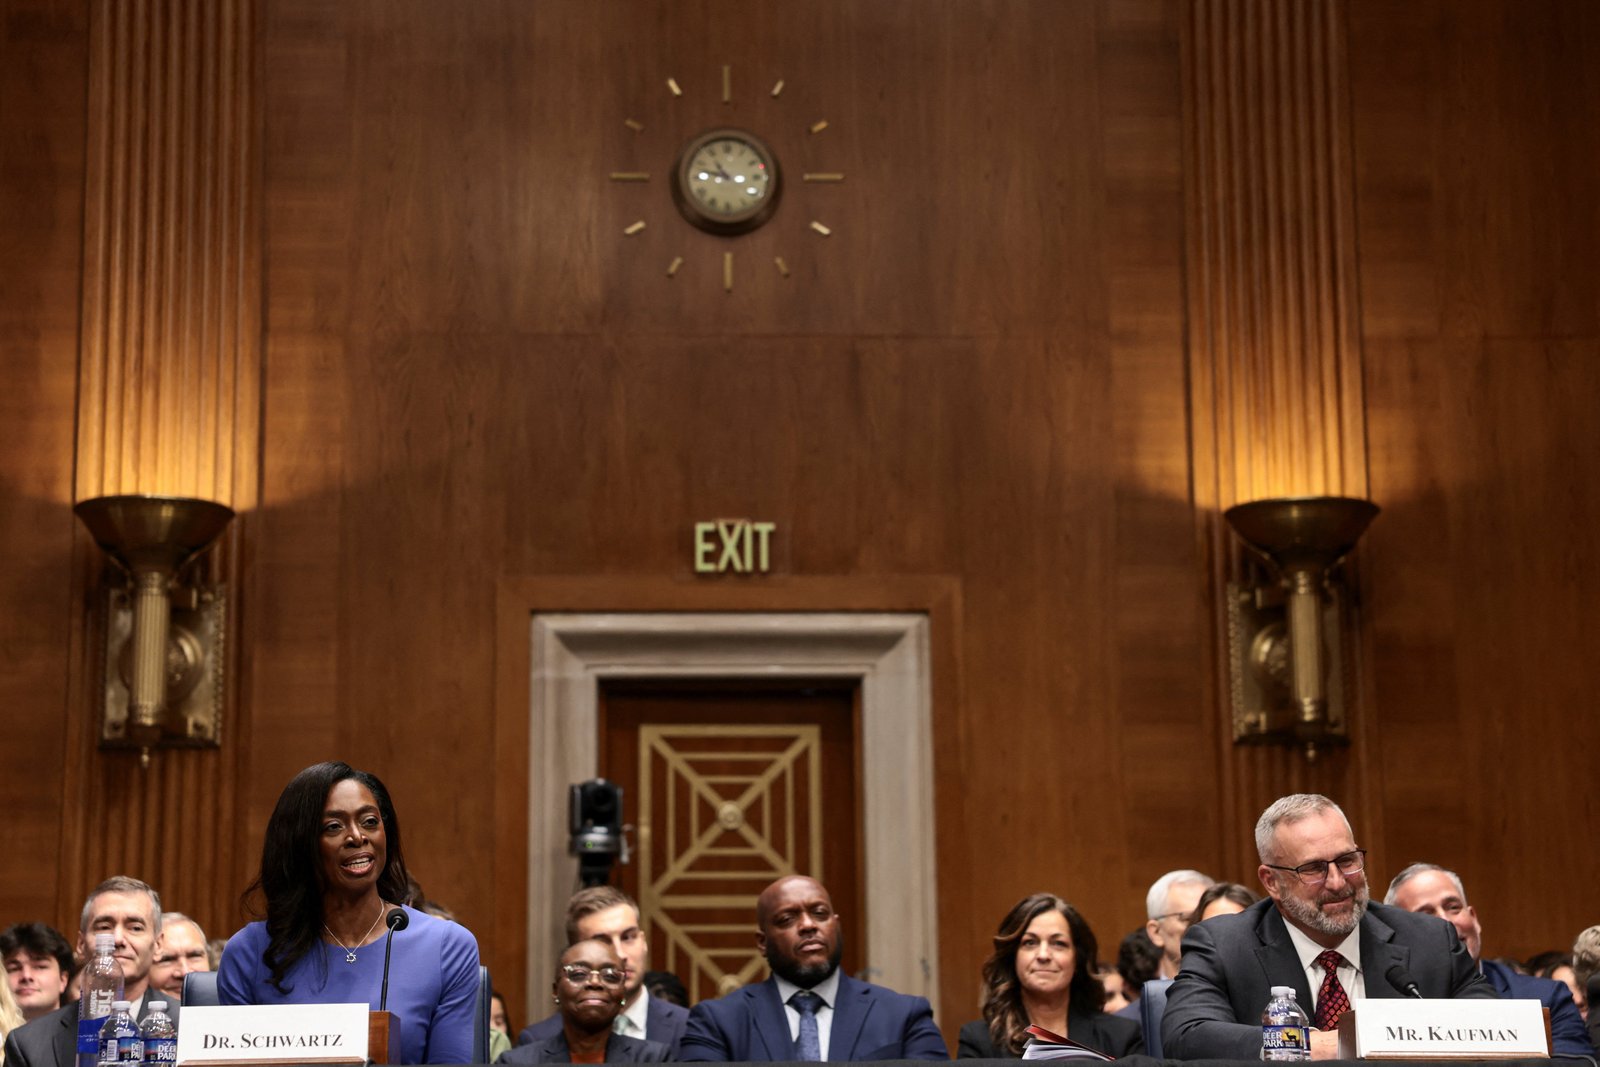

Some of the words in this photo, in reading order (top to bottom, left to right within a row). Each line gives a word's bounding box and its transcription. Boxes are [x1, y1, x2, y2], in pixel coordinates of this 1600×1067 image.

[694, 520, 776, 572] EXIT
[240, 1033, 343, 1049] SCHWARTZ
[1263, 1031, 1283, 1040] DEER
[1428, 1026, 1519, 1041] KAUFMAN
[1263, 1039, 1285, 1048] PARK
